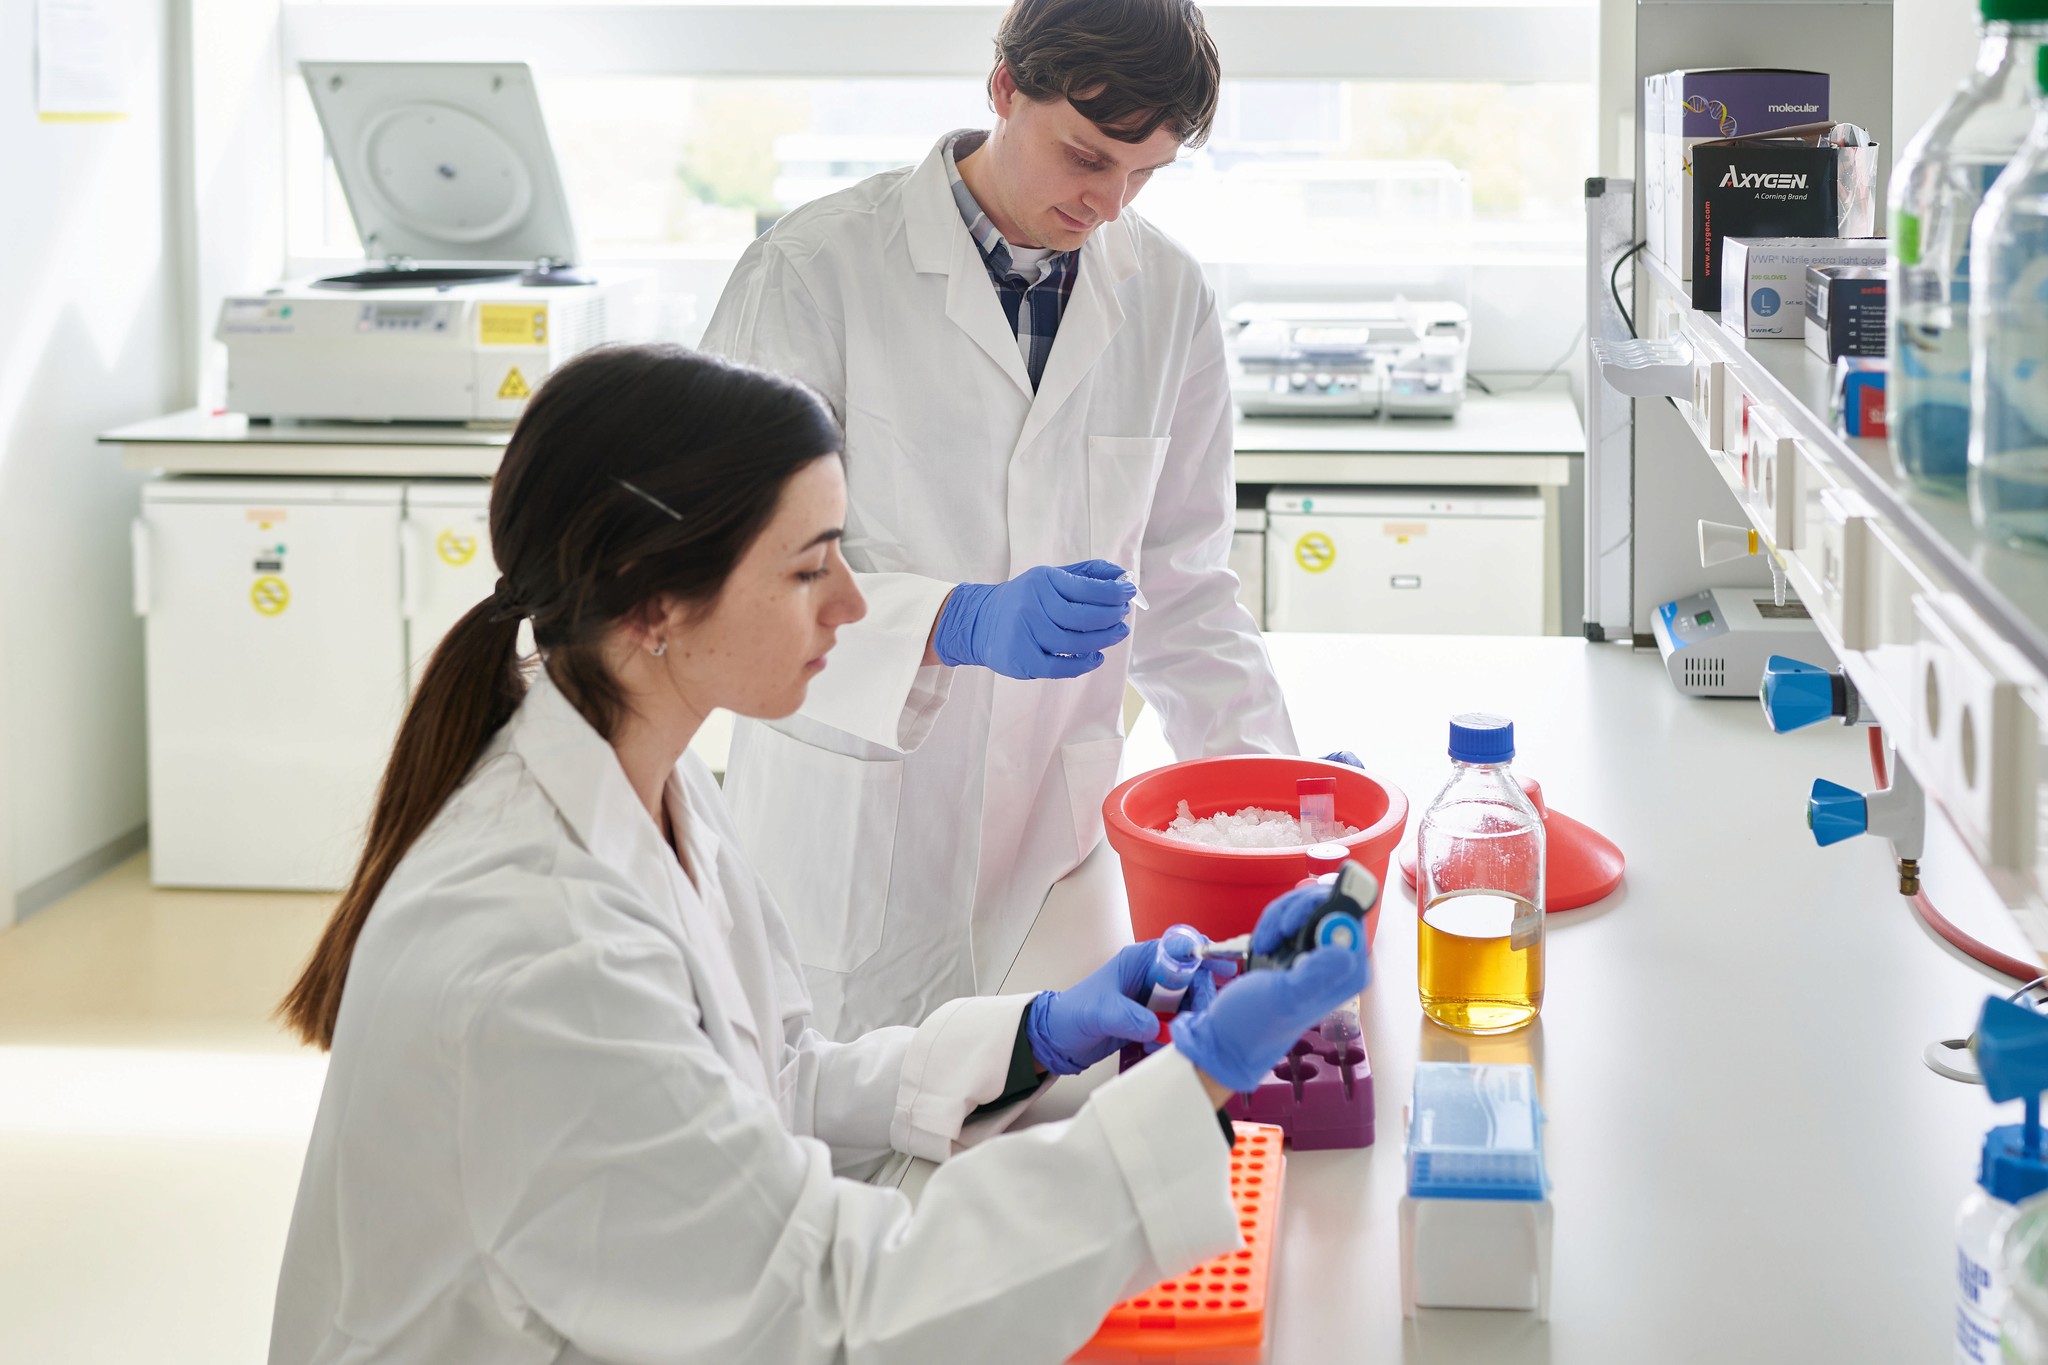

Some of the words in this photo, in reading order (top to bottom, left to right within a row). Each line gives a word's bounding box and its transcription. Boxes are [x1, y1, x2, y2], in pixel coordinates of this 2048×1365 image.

[1768, 103, 1820, 113] molecular
[1719, 165, 1807, 189] AXYGEN
[1761, 192, 1786, 201] Corning
[1782, 255, 1809, 264] Nitrile
[1811, 256, 1836, 264] extra
[1839, 255, 1859, 266] light
[1861, 255, 1887, 266] glove
[1761, 294, 1771, 309] L
